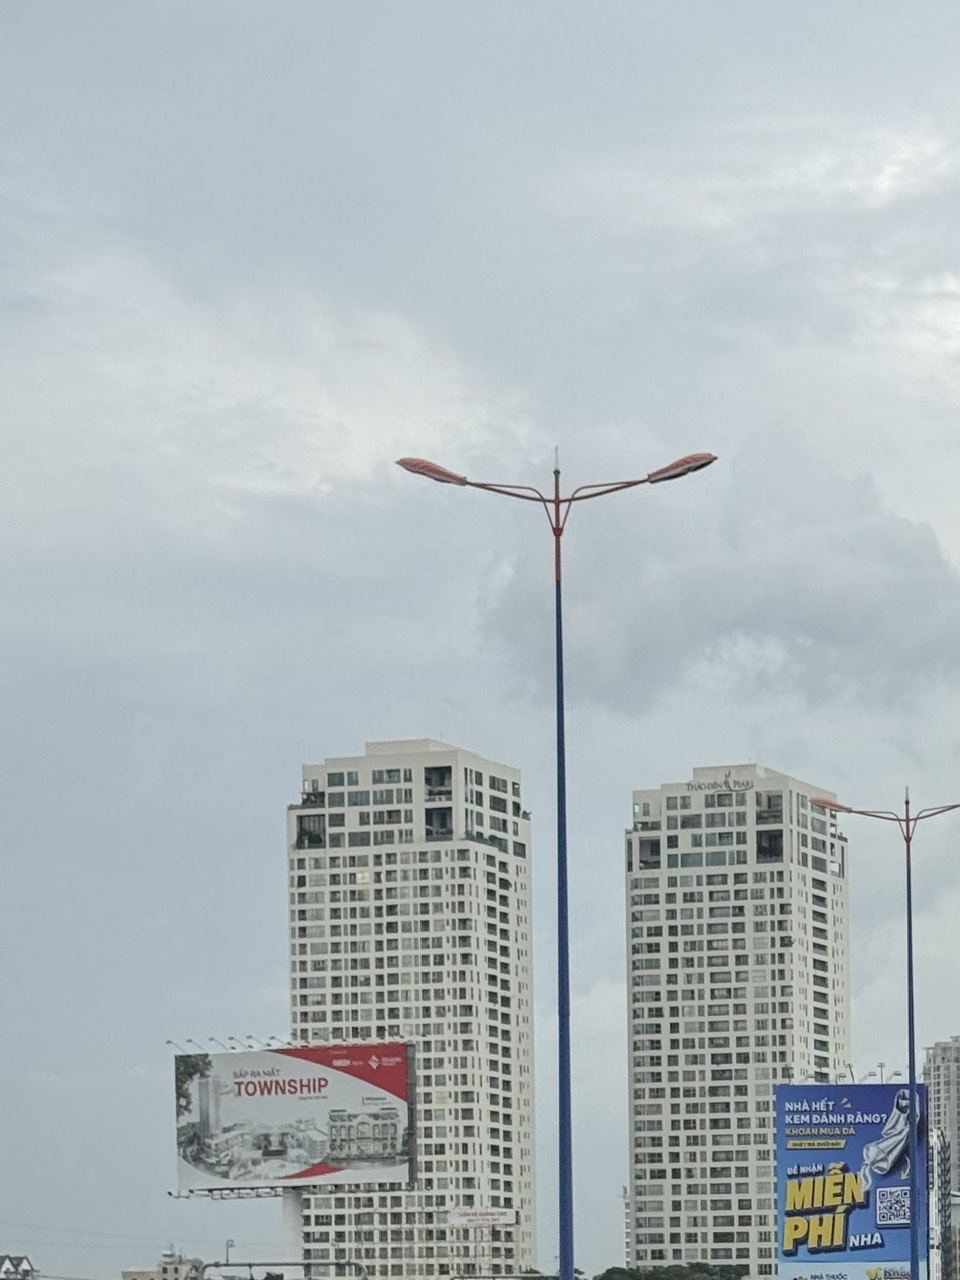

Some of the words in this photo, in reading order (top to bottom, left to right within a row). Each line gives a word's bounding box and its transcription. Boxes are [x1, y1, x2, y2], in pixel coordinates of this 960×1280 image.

[250, 1070, 262, 1078] RA
[233, 1077, 329, 1097] TOWNSHIP
[785, 1099, 811, 1112] NHÀ
[812, 1097, 835, 1112] HẾT
[785, 1114, 810, 1125] KEM
[811, 1111, 846, 1125] ĐÁNH
[846, 1111, 887, 1124] RĂNG?
[785, 1127, 819, 1136] KHOAN
[820, 1126, 841, 1136] MUA
[799, 1162, 823, 1175] NHẬN
[785, 1162, 865, 1211] MIỄN
[783, 1205, 846, 1250] PHÍ
[849, 1232, 882, 1248] NHA
[810, 1272, 824, 1280] NHÀ
[825, 1272, 848, 1280] THUỐC
